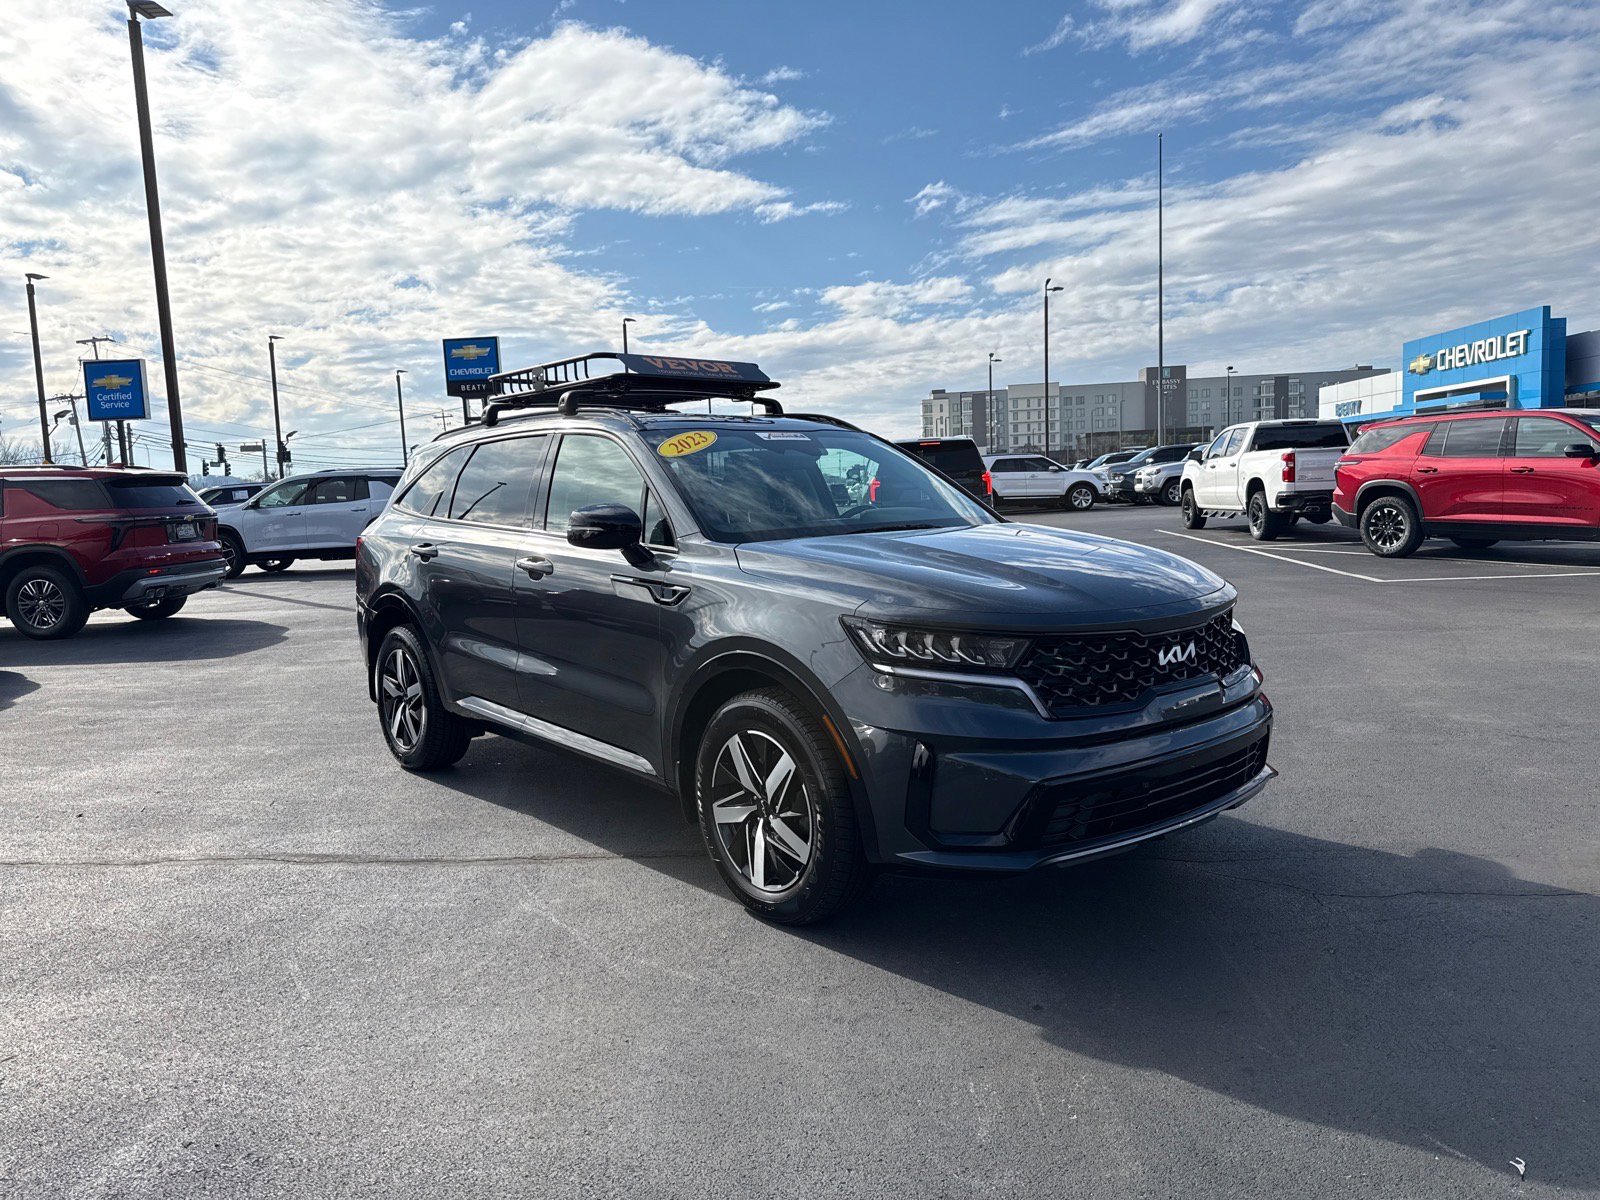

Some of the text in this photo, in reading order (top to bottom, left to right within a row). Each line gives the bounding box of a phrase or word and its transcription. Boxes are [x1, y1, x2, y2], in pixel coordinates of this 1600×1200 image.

[1437, 329, 1531, 371] CHEVROLET
[449, 367, 495, 376] CHEVROLET
[642, 356, 739, 374] VEVOR
[96, 392, 132, 401] Certified
[100, 401, 130, 409] Service
[669, 432, 708, 454] 2023
[1158, 641, 1196, 666] KIA
